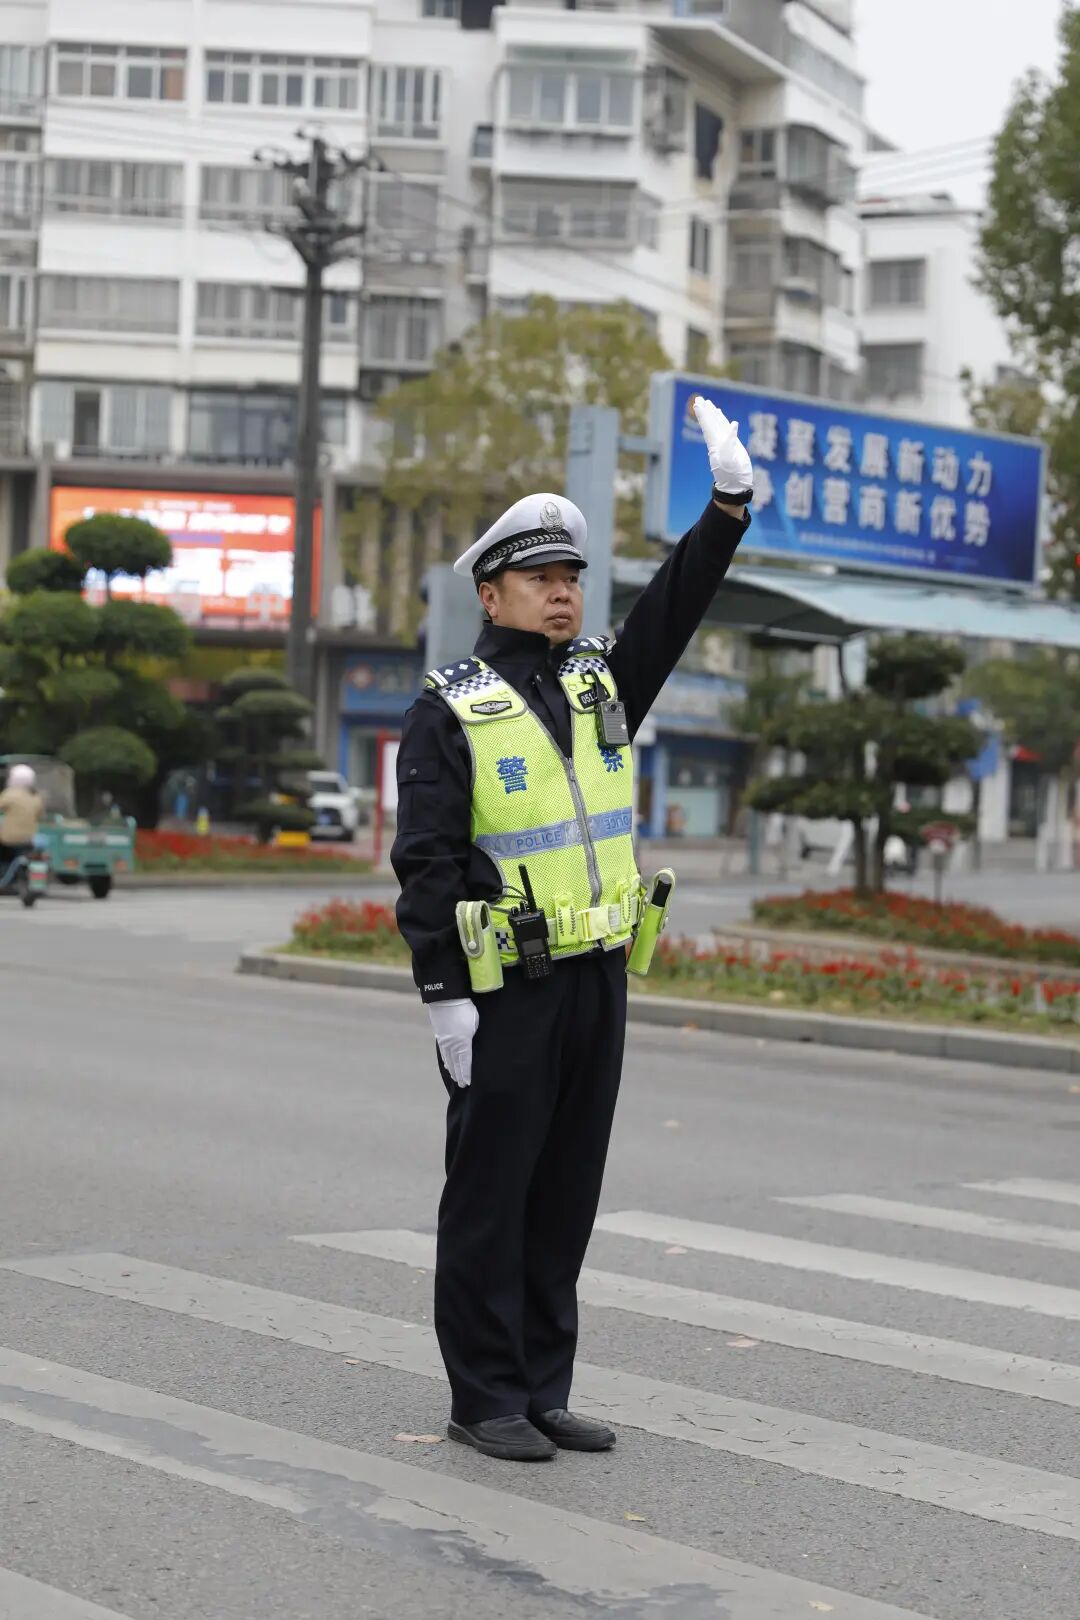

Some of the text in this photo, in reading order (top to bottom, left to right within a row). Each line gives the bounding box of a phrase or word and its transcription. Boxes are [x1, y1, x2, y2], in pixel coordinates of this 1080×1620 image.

[747, 410, 993, 497] 凝聚发展新动力
[750, 465, 991, 548] 争创营商新优势
[496, 756, 528, 794] 警
[516, 830, 561, 849] POLICE
[423, 982, 444, 991] POLICE
